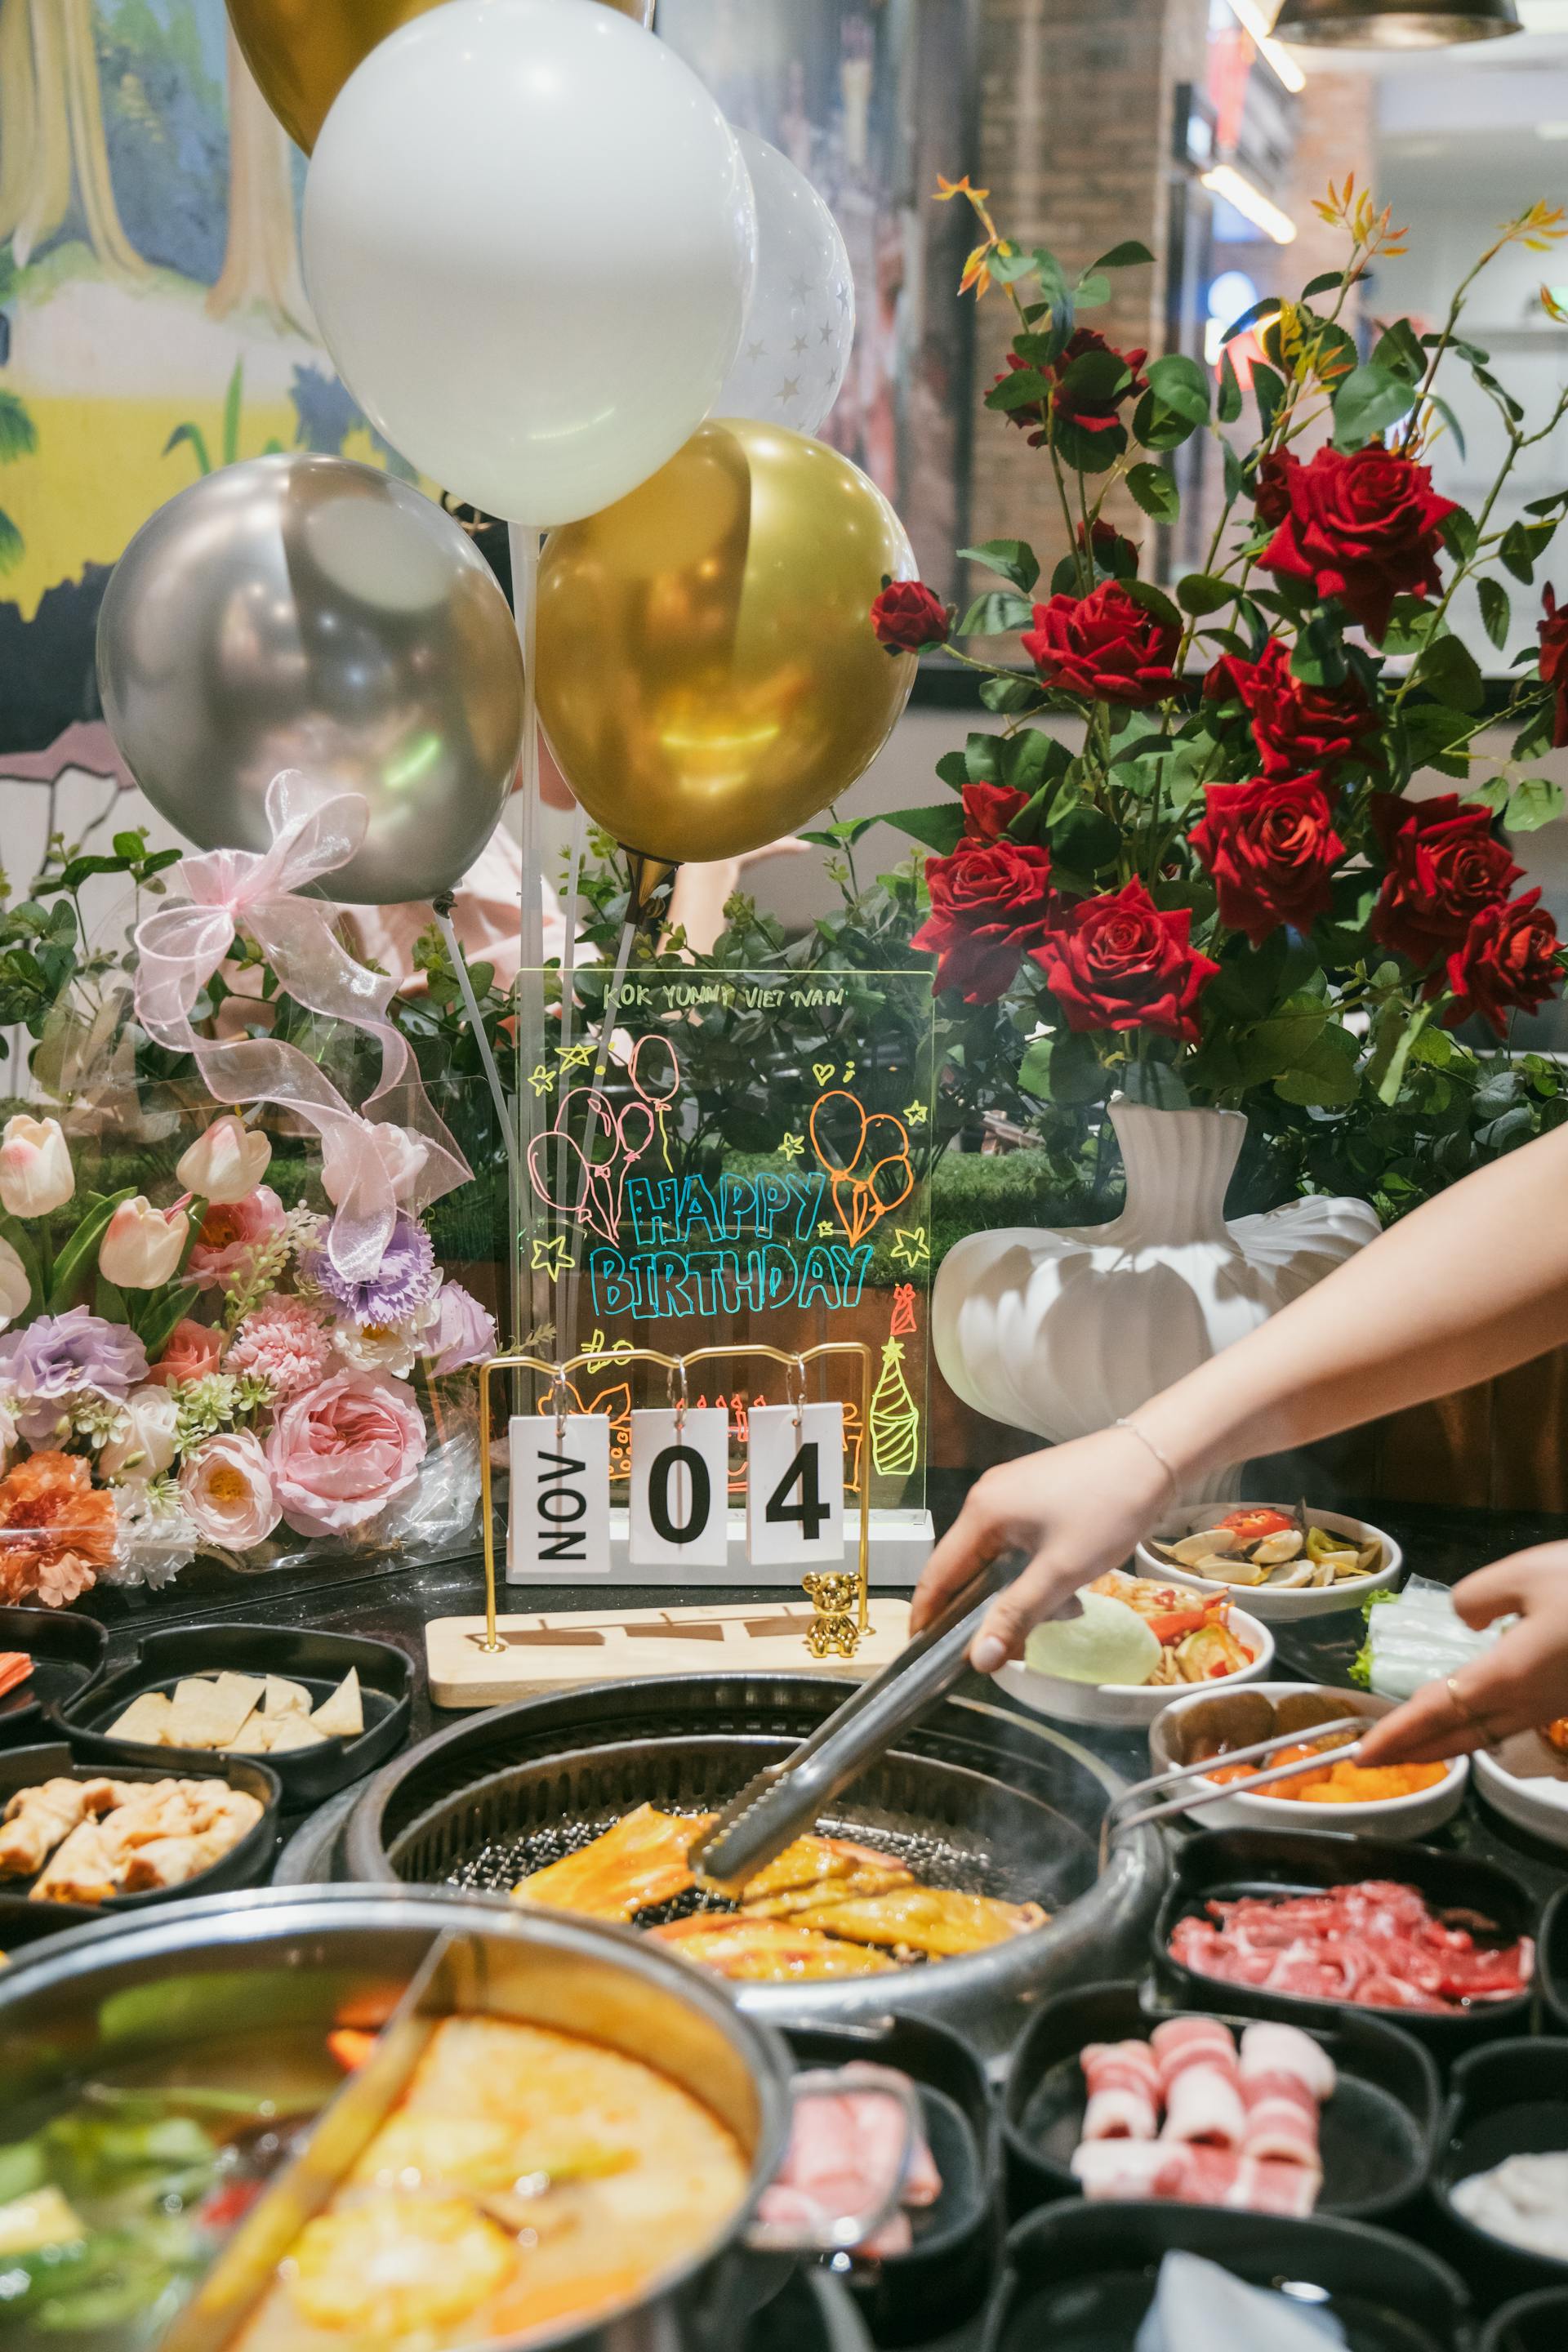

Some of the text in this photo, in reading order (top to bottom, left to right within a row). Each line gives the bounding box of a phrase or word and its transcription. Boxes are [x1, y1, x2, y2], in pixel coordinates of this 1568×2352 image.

[604, 983, 653, 1009] KOK
[744, 987, 786, 1009] VIET
[790, 987, 844, 1007] NAM
[625, 1171, 826, 1245] HAPPY
[590, 1243, 875, 1320] BIRTHDAY
[537, 1450, 587, 1561] NOV
[648, 1441, 831, 1544] 0 4
